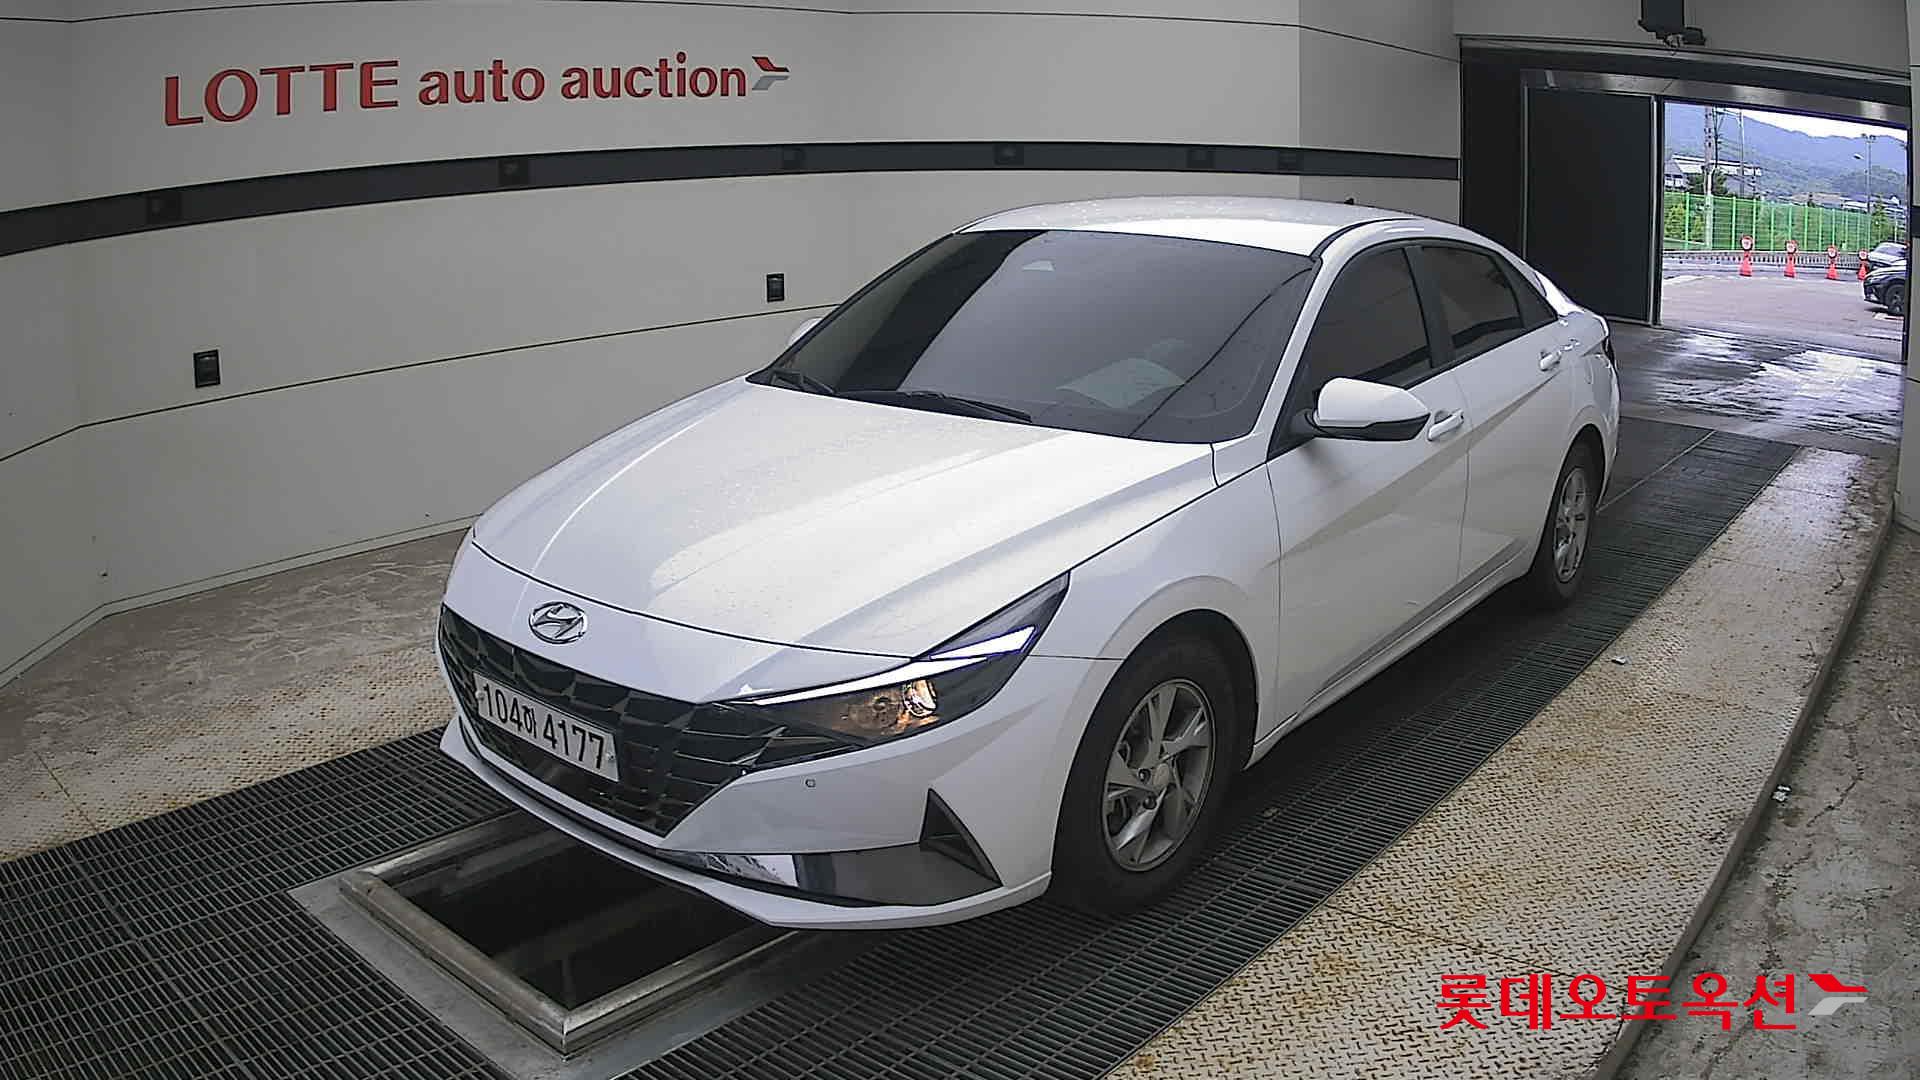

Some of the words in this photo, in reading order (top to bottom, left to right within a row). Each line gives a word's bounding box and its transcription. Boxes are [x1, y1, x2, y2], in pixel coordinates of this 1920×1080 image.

[165, 60, 400, 126] LOTTE
[418, 59, 546, 105] auto
[561, 51, 747, 99] auction
[543, 713, 605, 769] 4177
